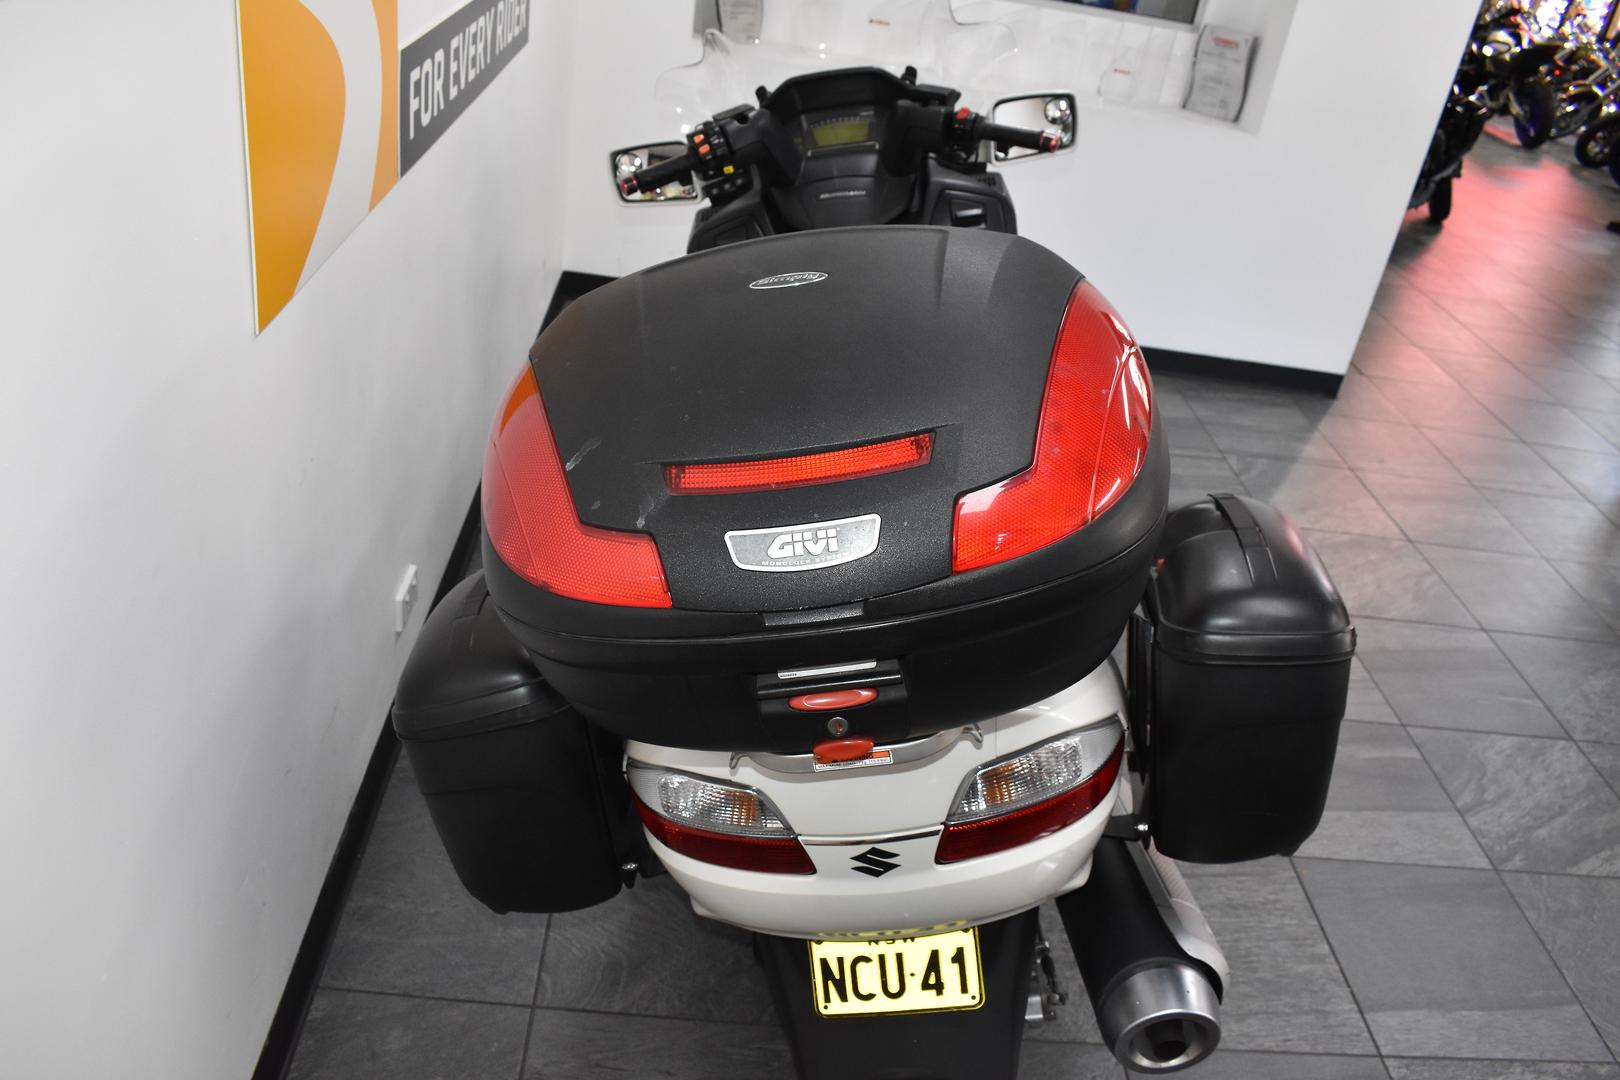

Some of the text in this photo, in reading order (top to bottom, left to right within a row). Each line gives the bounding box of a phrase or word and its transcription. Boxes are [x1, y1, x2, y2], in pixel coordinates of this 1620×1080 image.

[409, 0, 527, 141] FOR EVERY RIDER
[767, 528, 839, 559] GIVI
